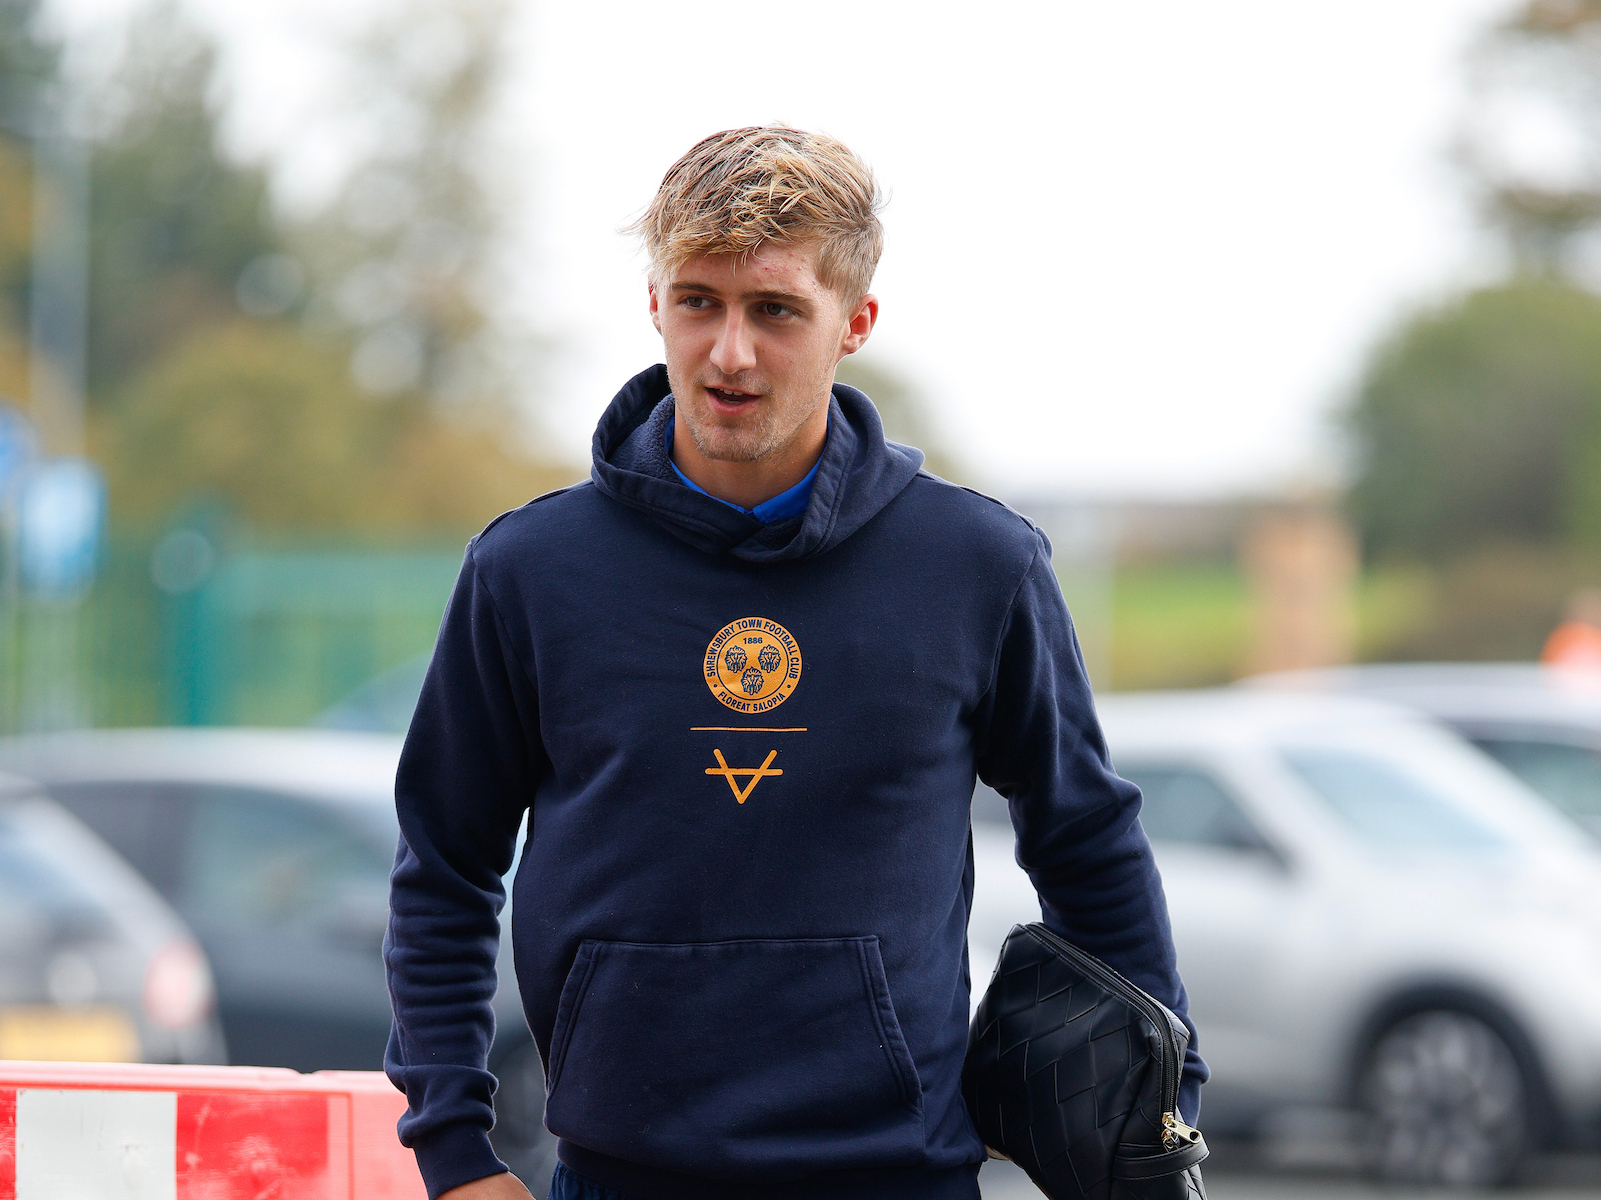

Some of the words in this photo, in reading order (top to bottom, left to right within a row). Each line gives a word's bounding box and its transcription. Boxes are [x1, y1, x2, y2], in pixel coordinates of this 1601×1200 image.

[706, 624, 736, 677] SHREWSBURY
[736, 619, 763, 630] TOWN
[763, 621, 798, 656] FOOTBALL
[788, 657, 800, 679] CLUB
[743, 636, 763, 645] 1886
[717, 691, 751, 711] FLOREAT
[753, 692, 786, 711] SALOPIA
